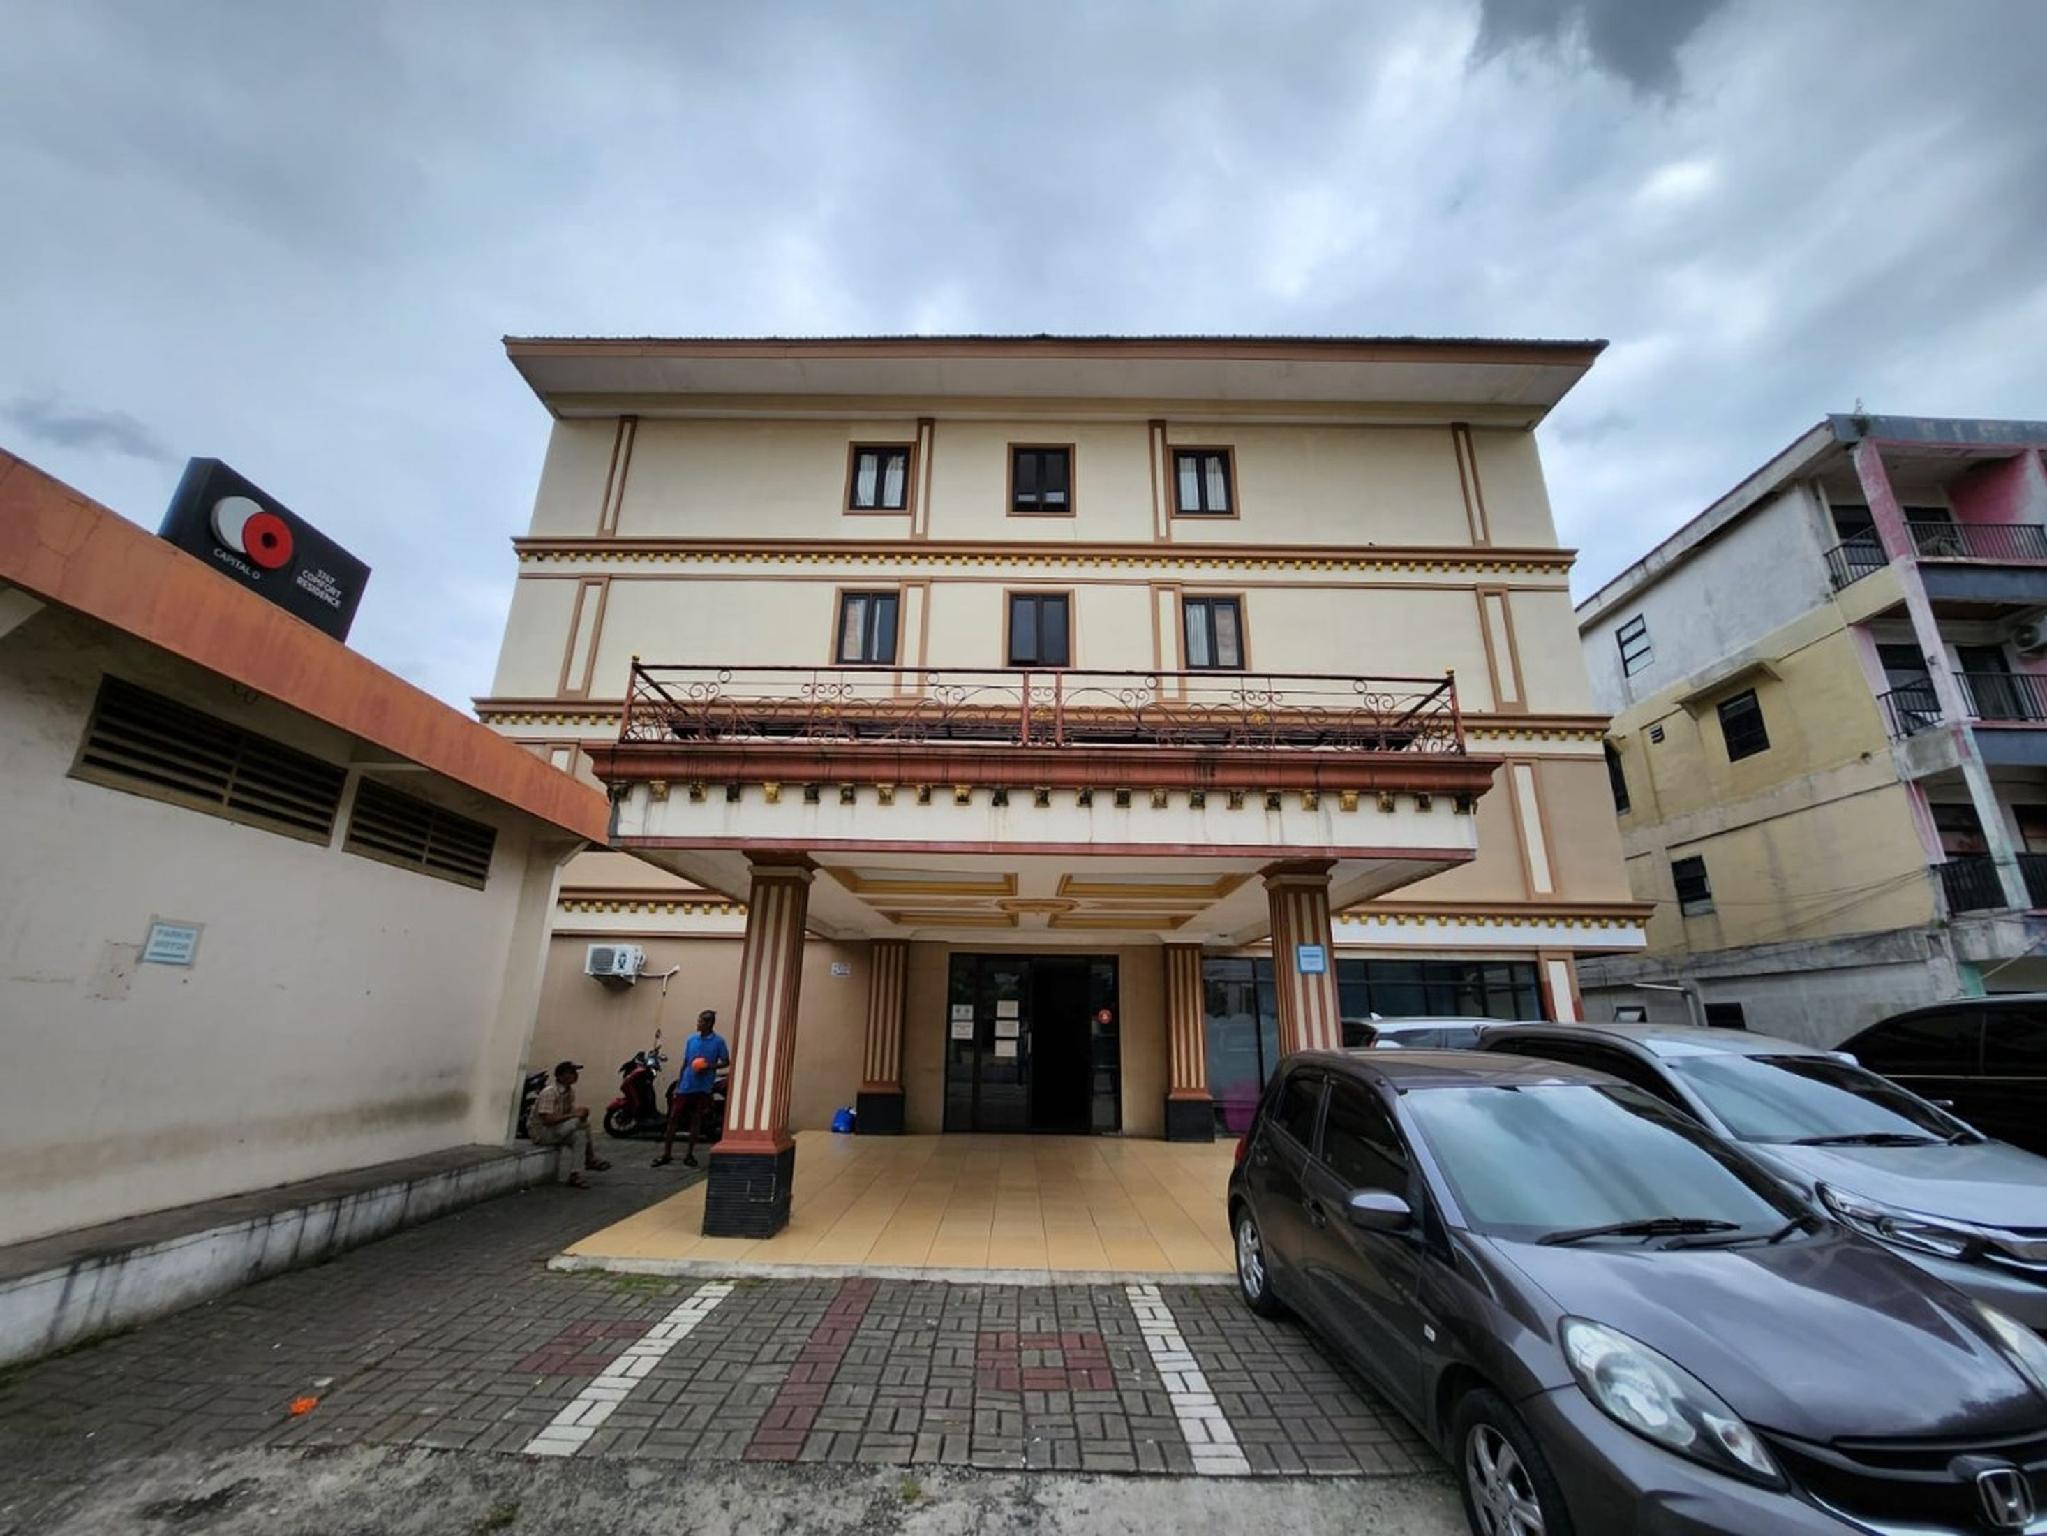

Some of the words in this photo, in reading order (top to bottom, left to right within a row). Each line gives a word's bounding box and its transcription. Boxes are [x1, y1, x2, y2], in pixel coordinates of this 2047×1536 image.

[213, 548, 250, 575] CAPITAL
[252, 570, 261, 580] O
[296, 576, 341, 608] RESIDENCE
[302, 570, 342, 598] COMFORT
